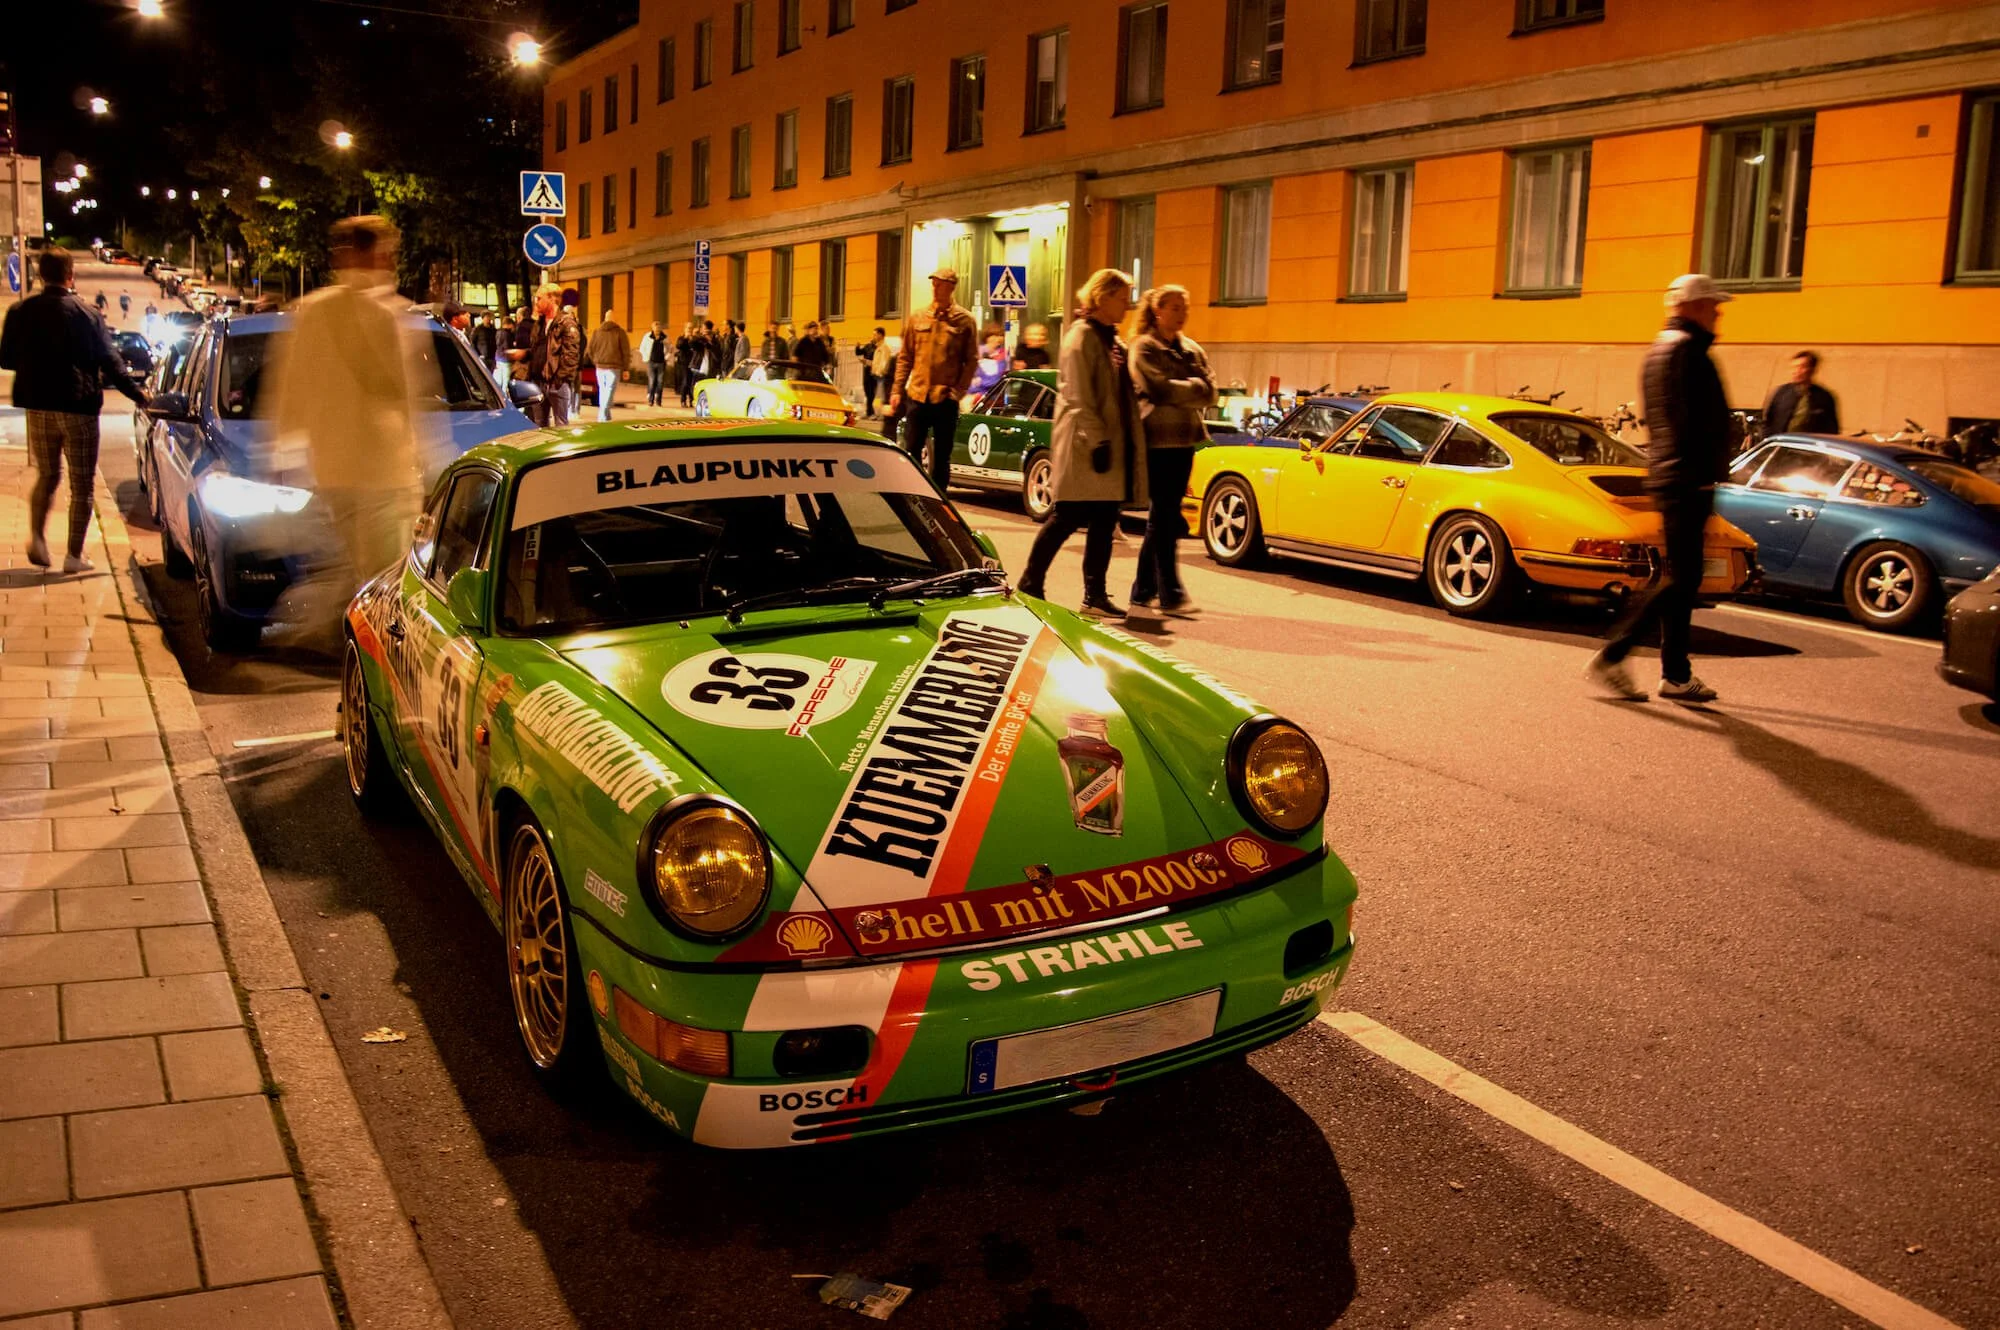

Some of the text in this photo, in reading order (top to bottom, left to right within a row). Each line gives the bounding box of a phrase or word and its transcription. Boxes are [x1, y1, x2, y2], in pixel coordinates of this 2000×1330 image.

[700, 242, 709, 255] P
[971, 433, 988, 456] 30
[596, 458, 839, 494] BLAUPUNKT
[689, 656, 810, 711] 33
[787, 657, 847, 736] PORSCHE
[437, 655, 461, 770] 33
[839, 741, 867, 773] Nette
[856, 694, 896, 741] Menschen
[824, 618, 1030, 879] KUEMMERLING
[978, 757, 1006, 783] Der
[994, 721, 1021, 756] sanfte
[989, 886, 1074, 928] mit
[960, 921, 1204, 992] STRÄHLE
[1279, 966, 1340, 1006] BOSCH
[759, 1085, 868, 1112] BOSCH
[978, 1072, 988, 1084] S
